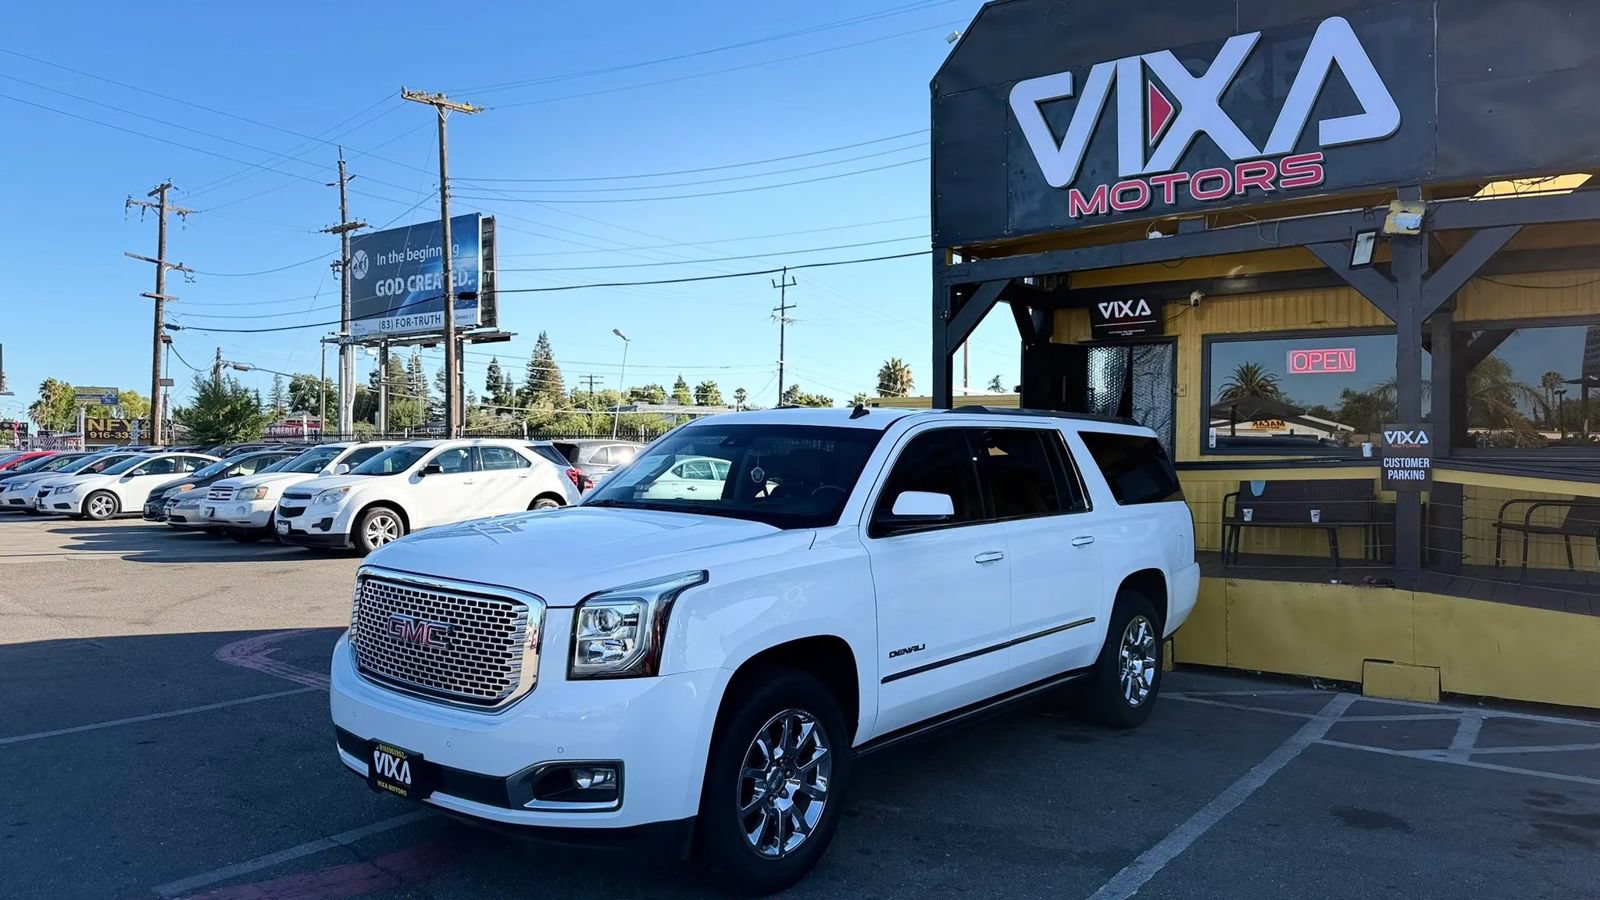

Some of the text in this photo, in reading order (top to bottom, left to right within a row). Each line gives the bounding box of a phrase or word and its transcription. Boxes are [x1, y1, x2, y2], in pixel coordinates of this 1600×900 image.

[1009, 16, 1401, 188] VIXA
[1068, 152, 1325, 218] MOTORS
[376, 244, 460, 266] In the beginng
[375, 271, 472, 297] GOD CREAED.
[1098, 298, 1152, 319] VIXA
[378, 319, 394, 331] (83)
[395, 314, 441, 328] FOR-TRUTH
[1293, 351, 1354, 371] OPEN
[1383, 430, 1429, 445] VIXA
[1383, 457, 1430, 468] CUSTOMER
[1387, 469, 1426, 481] PARKING
[388, 614, 453, 650] GMC
[889, 643, 926, 659] DENALI
[373, 750, 412, 785] VIXA
